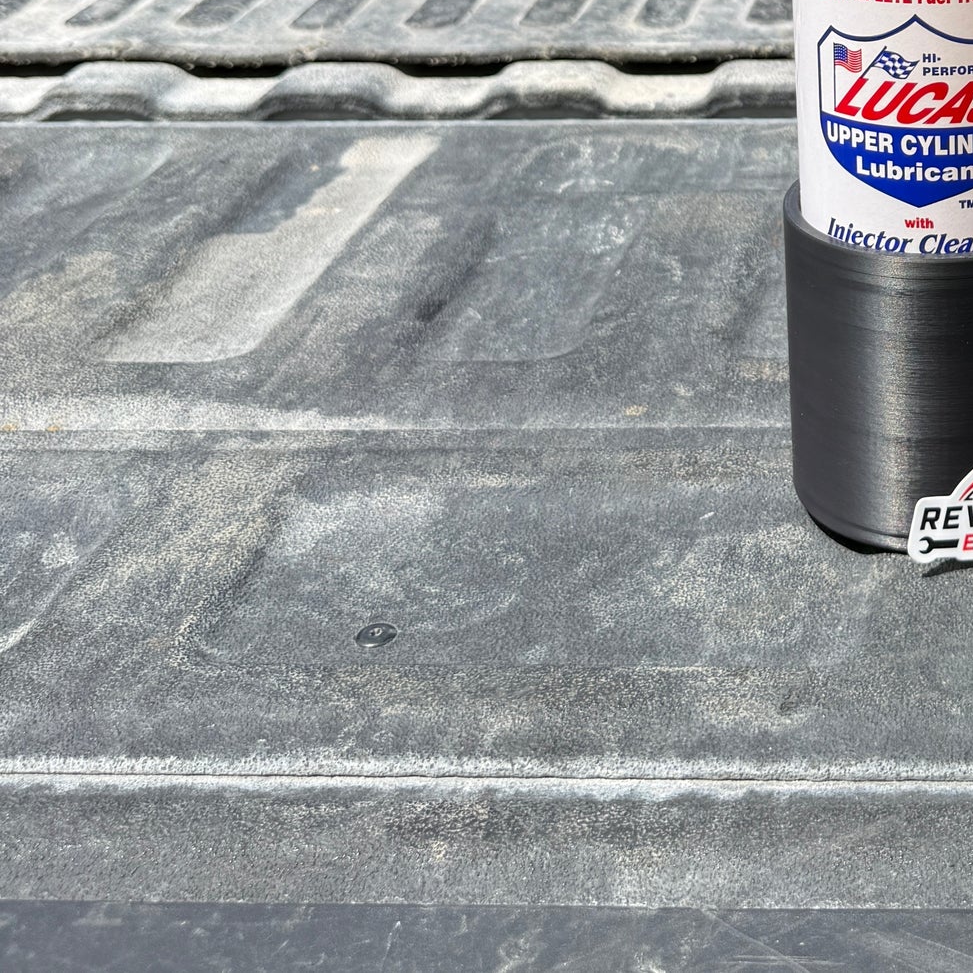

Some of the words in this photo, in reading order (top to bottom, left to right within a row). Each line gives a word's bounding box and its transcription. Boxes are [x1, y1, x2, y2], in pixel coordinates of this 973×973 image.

[922, 53, 941, 64] HI-
[826, 121, 894, 154] UPPER
[904, 217, 934, 229] with
[827, 217, 913, 254] Injector
